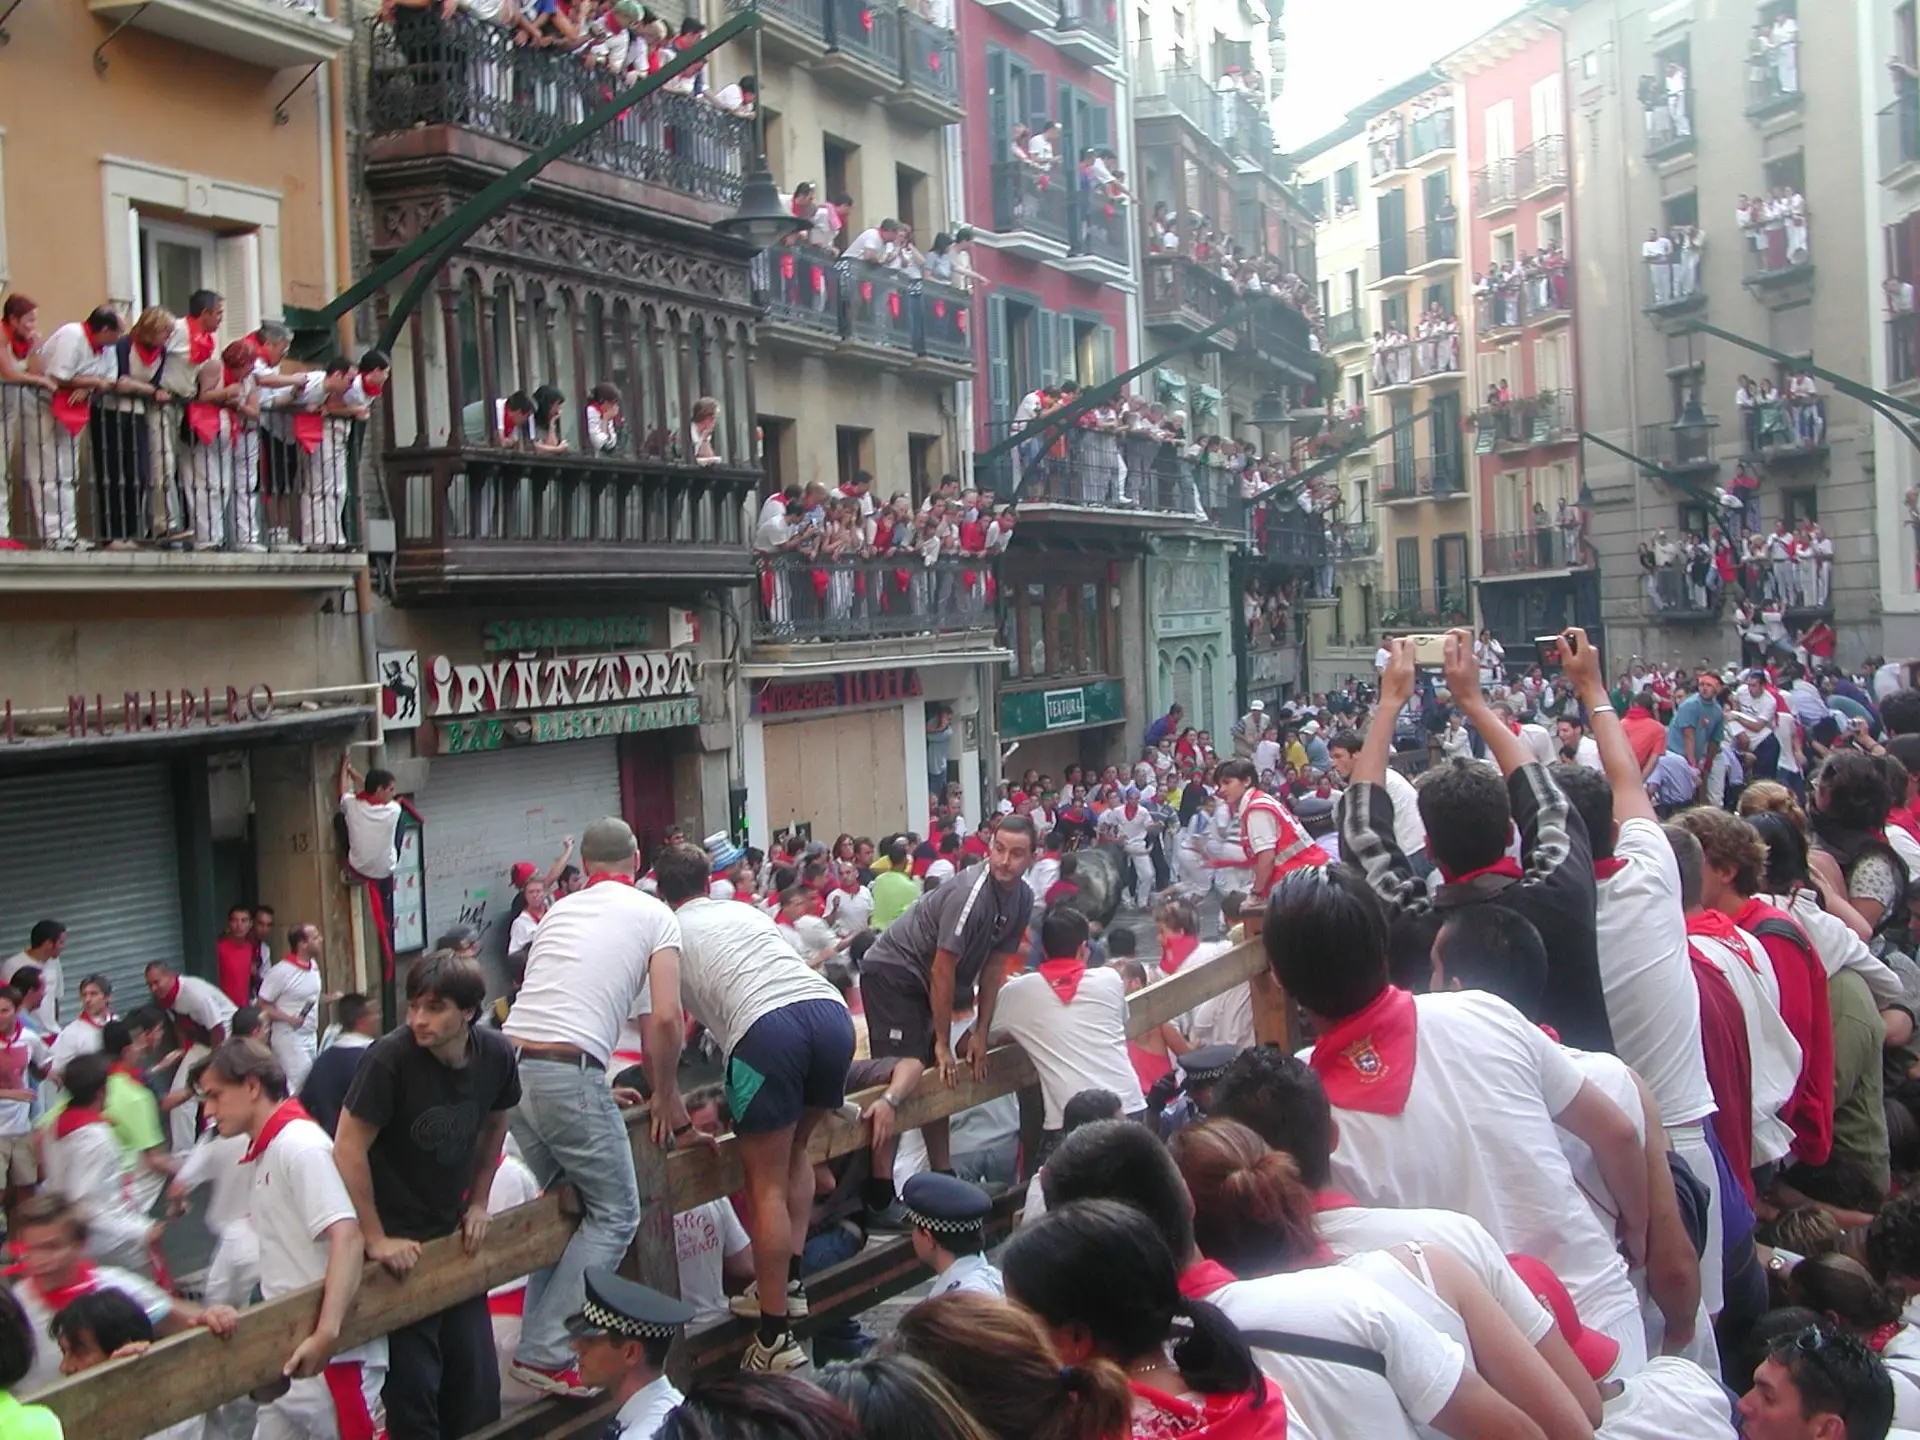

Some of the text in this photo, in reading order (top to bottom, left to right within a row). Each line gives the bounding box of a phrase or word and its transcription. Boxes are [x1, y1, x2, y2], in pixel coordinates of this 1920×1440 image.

[1048, 699, 1083, 717] TEXTURA
[447, 719, 504, 754] BAR
[292, 832, 309, 852] 13
